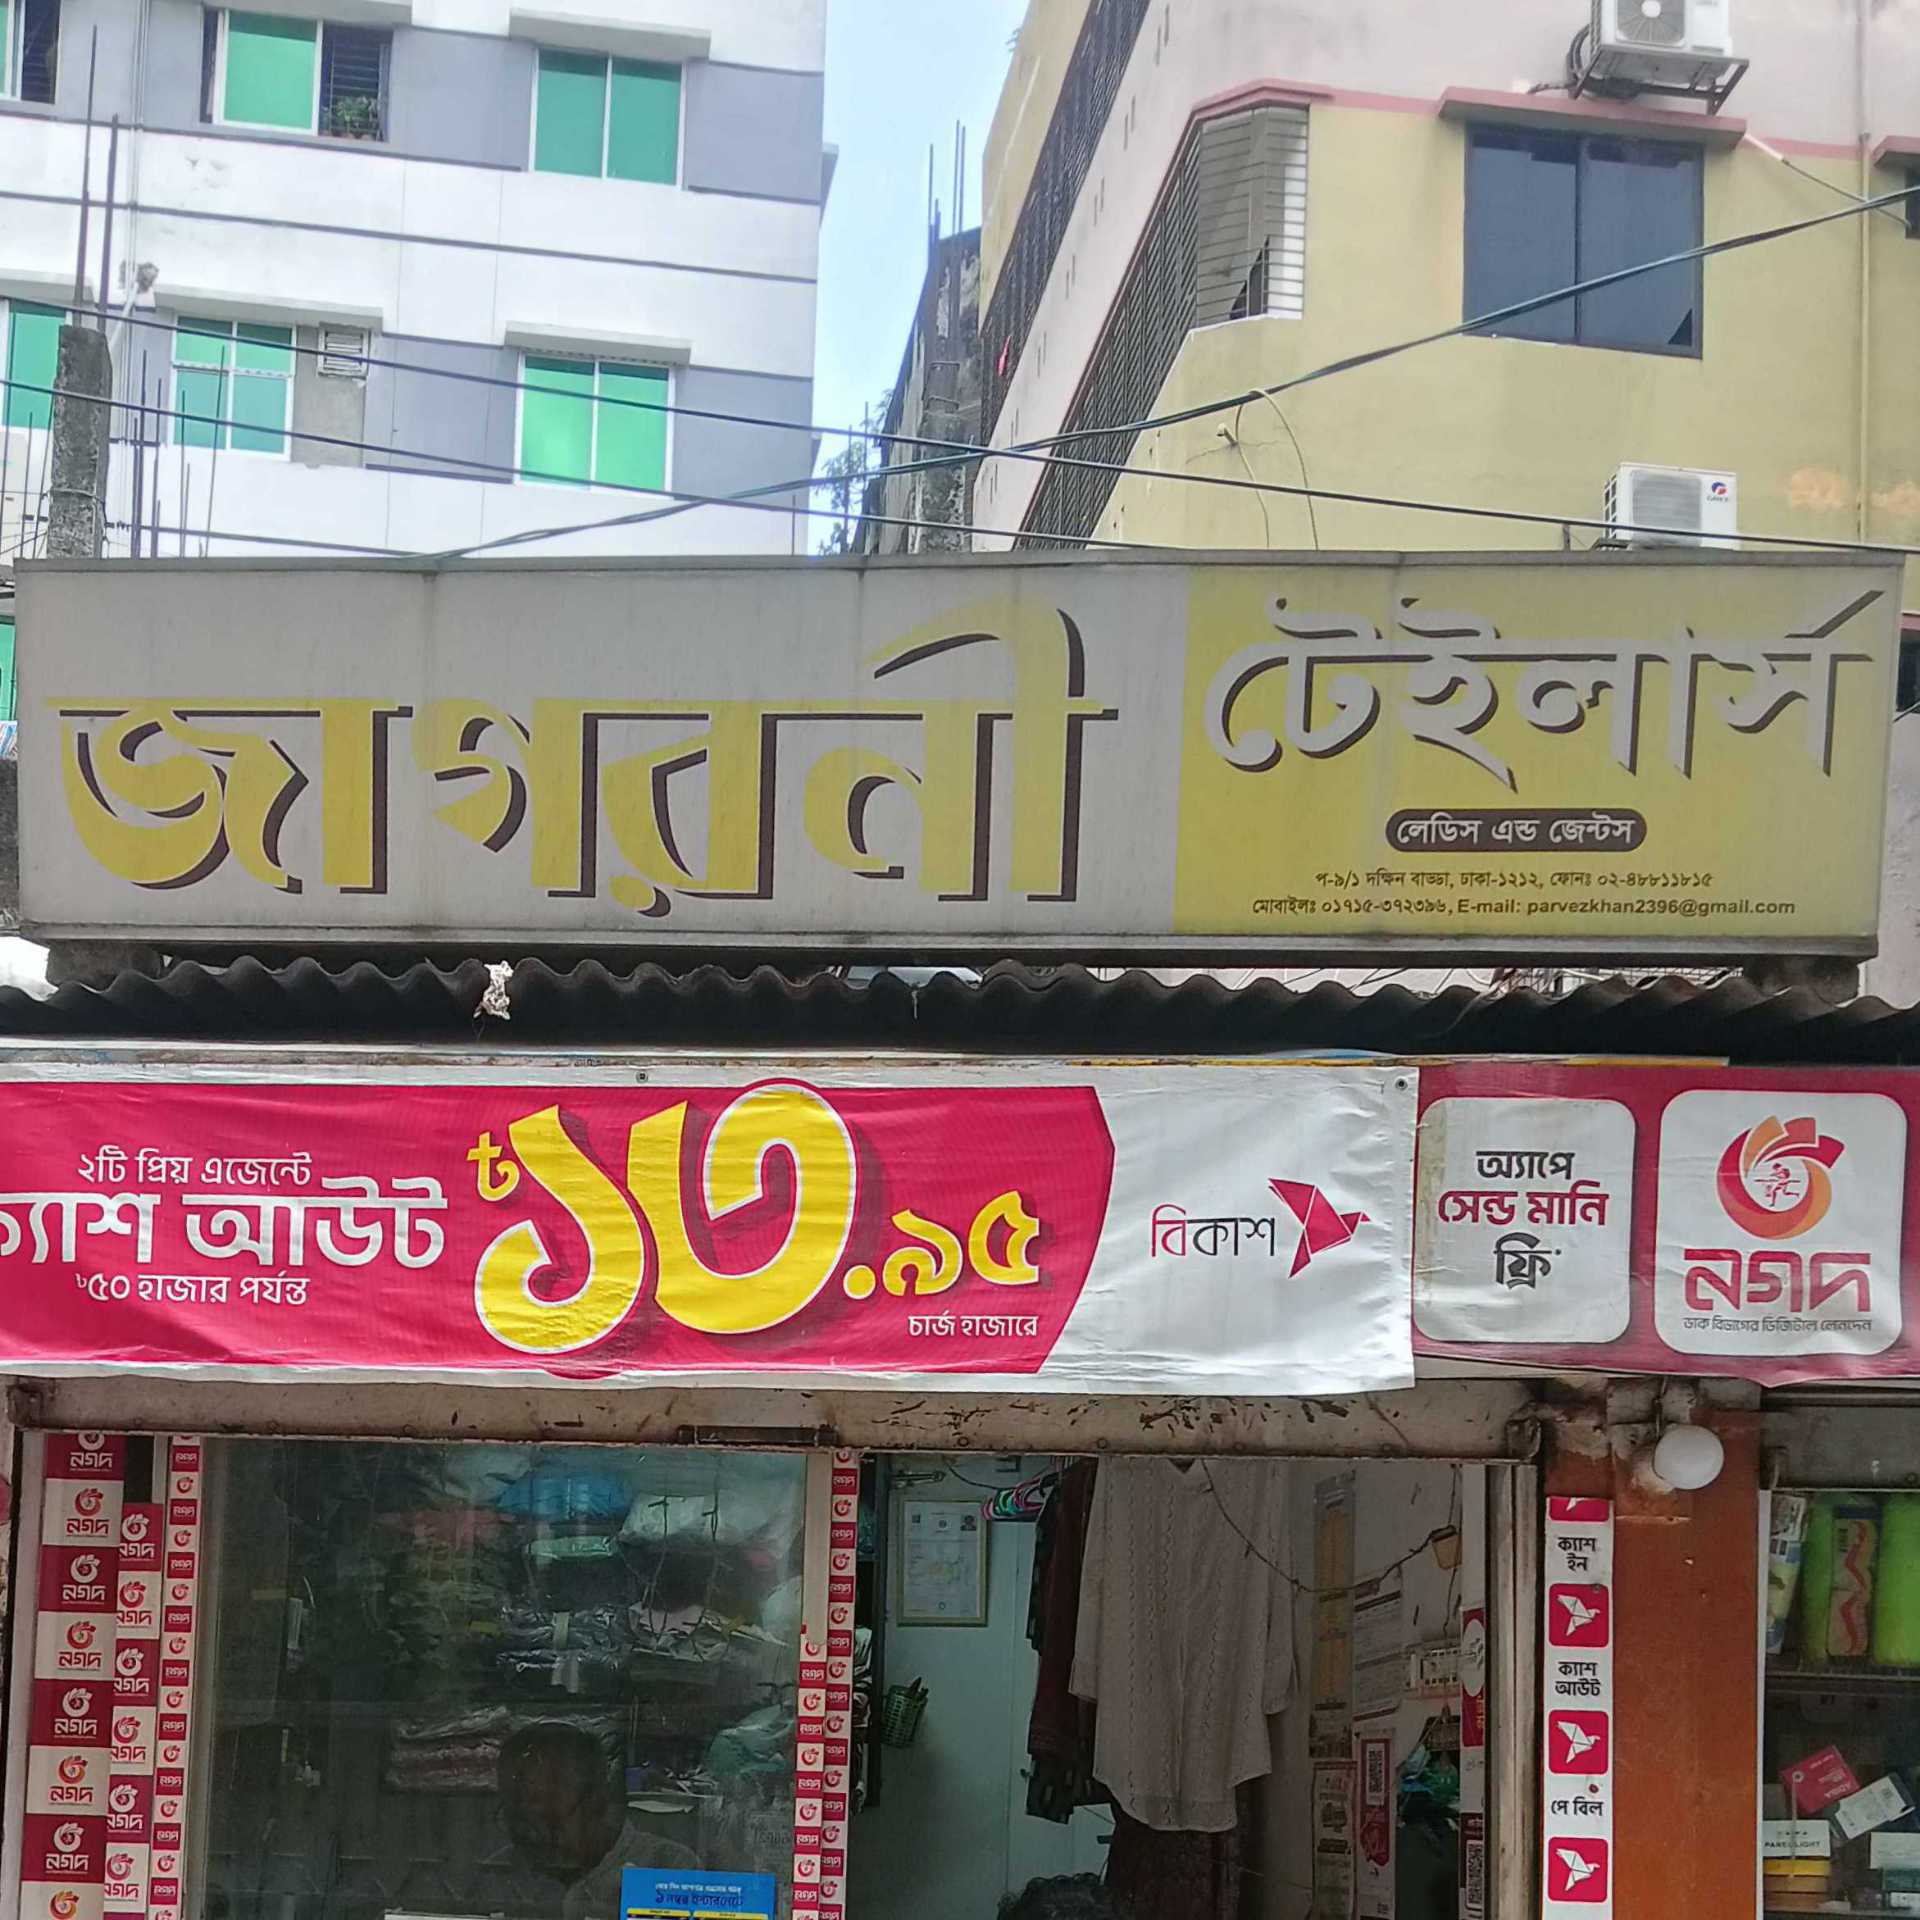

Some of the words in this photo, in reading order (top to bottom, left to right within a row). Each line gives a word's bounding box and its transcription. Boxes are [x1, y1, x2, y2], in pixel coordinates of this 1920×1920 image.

[46, 593, 1118, 917] জাগরনী
[1204, 590, 1885, 794] টেইলার্স
[1397, 812, 1483, 844] লেডিস
[1491, 817, 1541, 843] এন্ড
[1549, 811, 1637, 844] জেন্টস
[1457, 899, 1522, 914] E-mail:
[1527, 899, 1796, 917] parvezkhan2396@gmail.com
[78, 1144, 129, 1184] ২টি
[136, 1147, 193, 1185] প্রিয়
[200, 1151, 313, 1187] এজেন্টে
[1476, 1151, 1576, 1180] অ্যাপে
[1438, 1189, 1519, 1226] সেন্ড
[1526, 1179, 1610, 1226] মানি
[182, 1175, 449, 1269] আউট
[1151, 1202, 1276, 1257] বিকাশ
[138, 1273, 231, 1304] হাজার
[239, 1270, 311, 1305] পর্যন্ত
[1684, 1248, 1872, 1313] নগদ
[908, 1312, 957, 1338] চার্জ
[962, 1314, 1039, 1338] হাজারে
[70, 1452, 113, 1468] নগদ
[66, 1518, 109, 1534] নগদ
[1557, 1536, 1597, 1552] ক্যাশ
[1566, 1553, 1588, 1572] ইন
[62, 1585, 106, 1600] নগদ
[59, 1651, 102, 1667] নগদ
[1558, 1661, 1599, 1677] ক্যাশ
[1555, 1678, 1602, 1697] আউট
[54, 1718, 97, 1735] নগদ
[50, 1786, 94, 1802] নগদ
[1551, 1799, 1569, 1816] পে
[1572, 1796, 1605, 1817] বিল
[46, 1853, 89, 1870] নগদ
